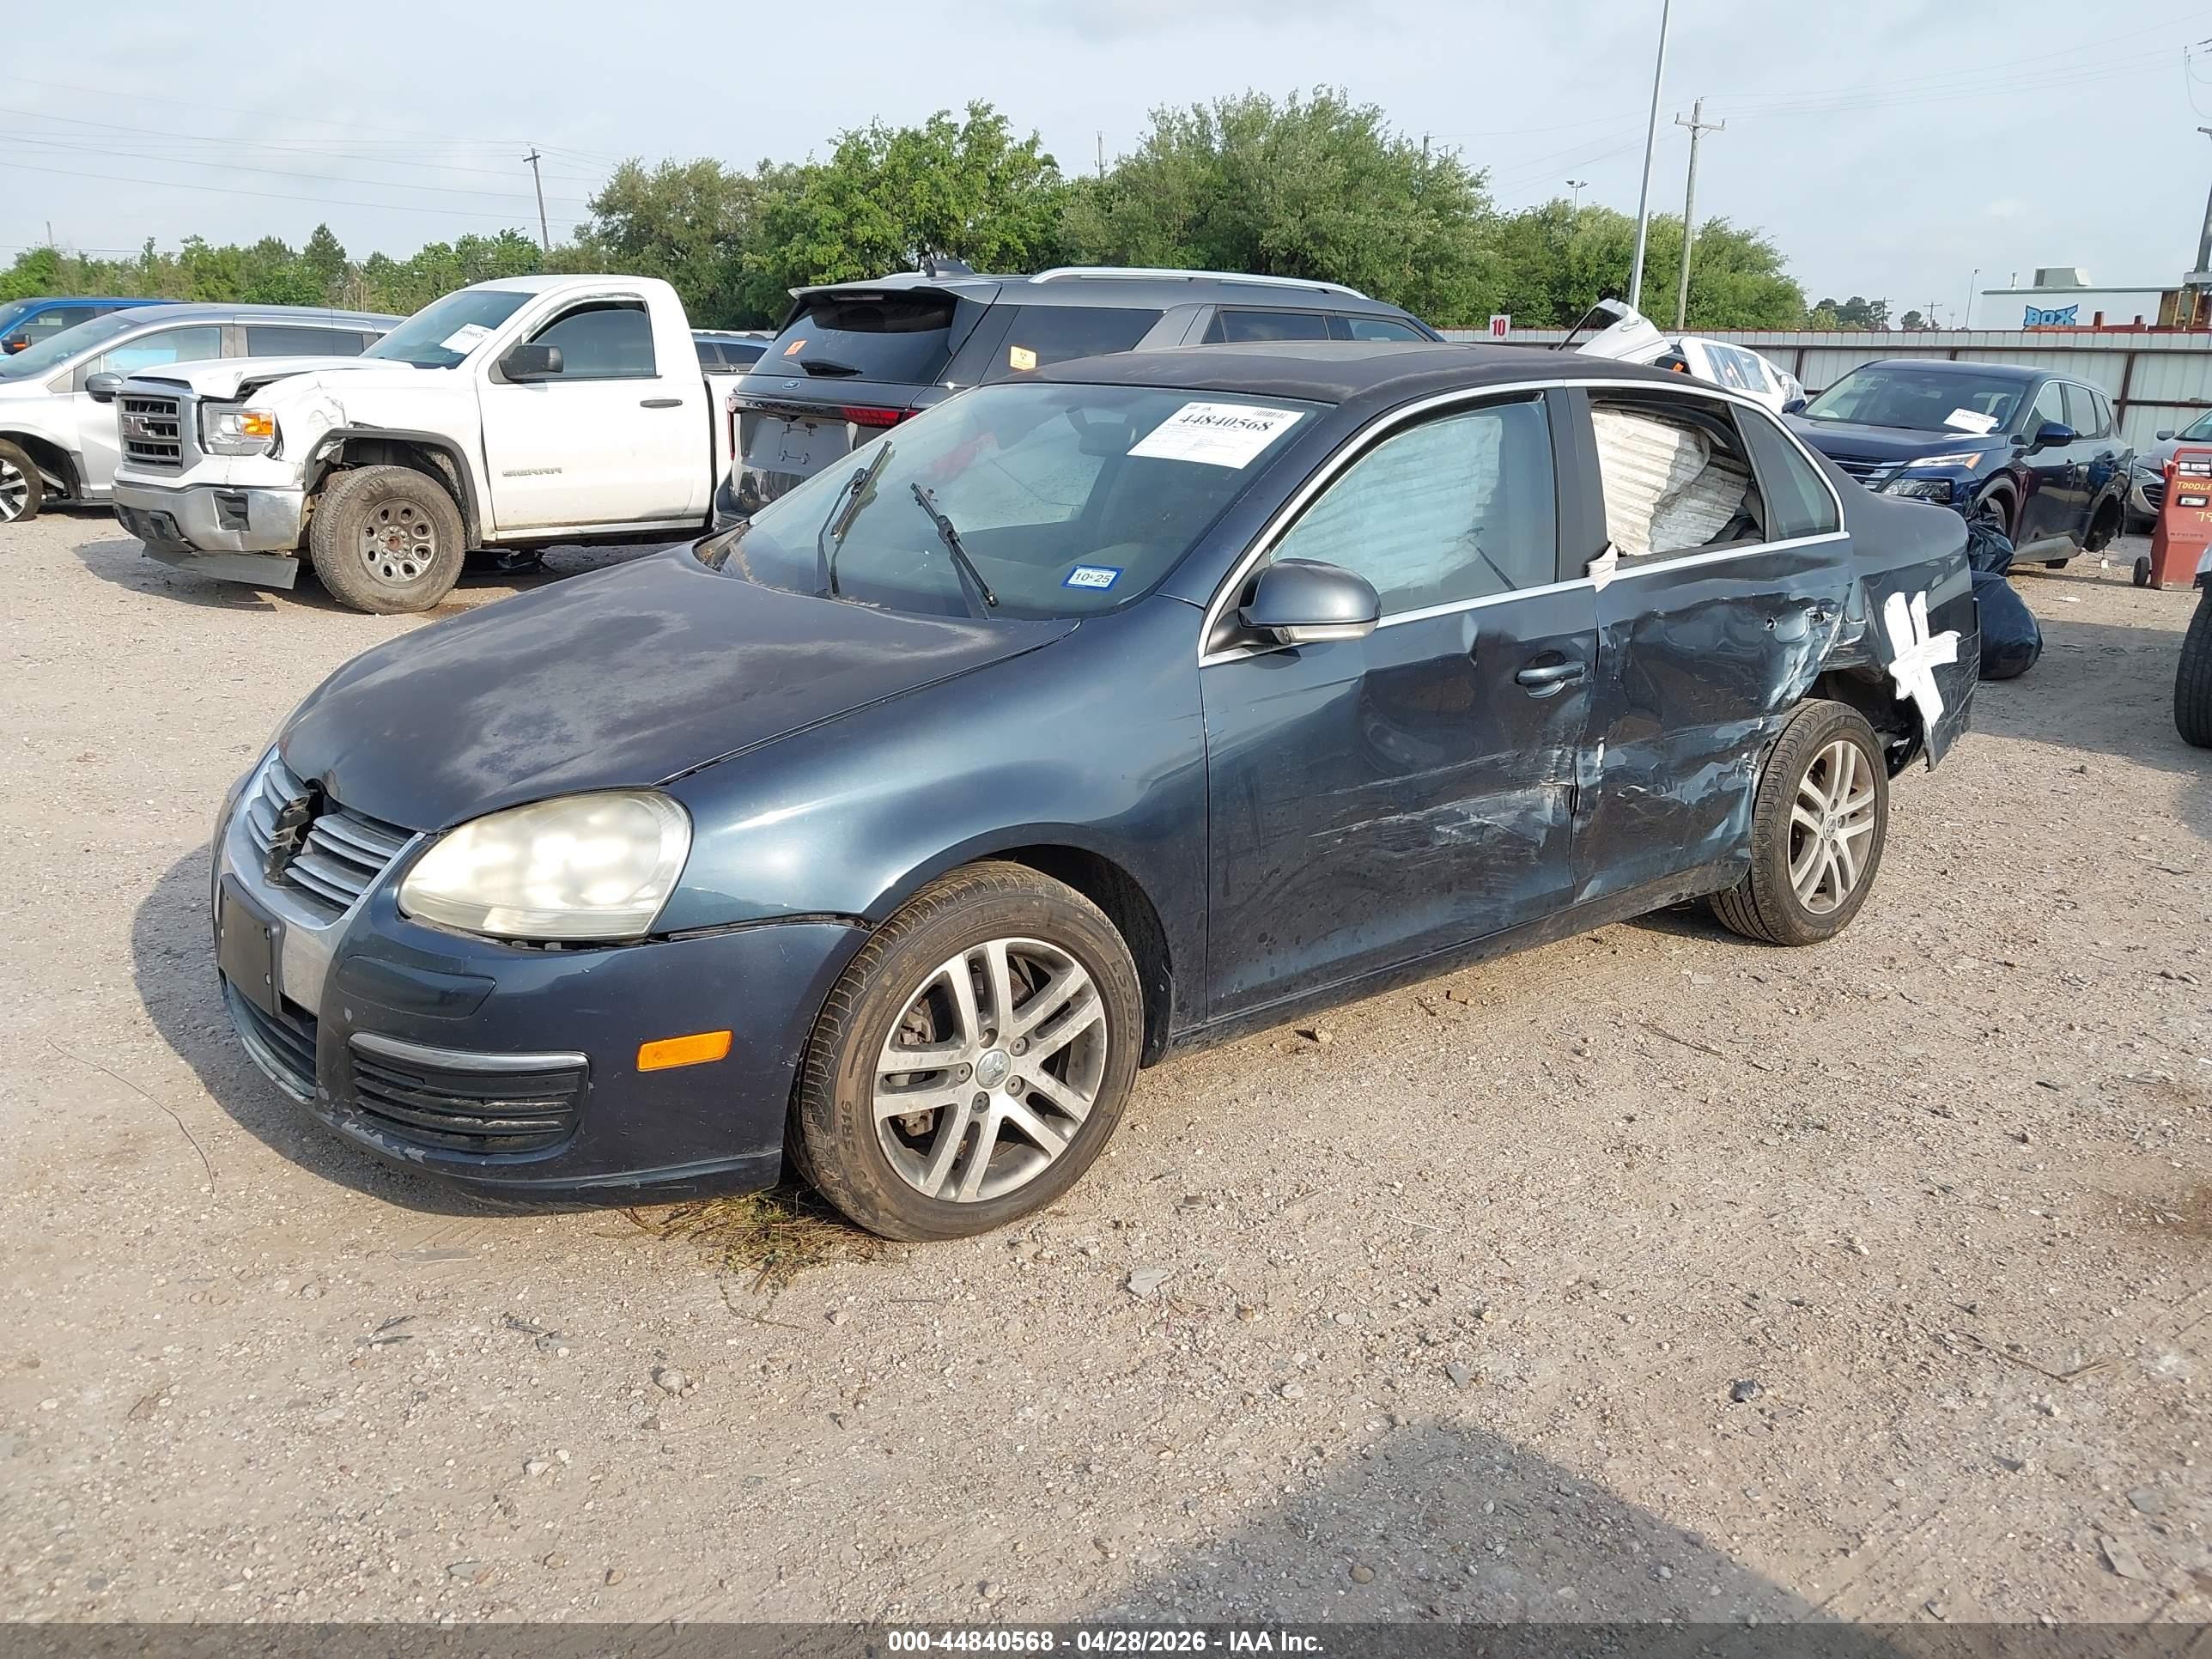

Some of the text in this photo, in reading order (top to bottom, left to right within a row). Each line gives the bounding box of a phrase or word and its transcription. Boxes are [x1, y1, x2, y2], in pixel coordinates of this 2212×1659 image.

[2024, 303, 2078, 326] BOX
[1492, 319, 1505, 336] 10
[1179, 413, 1274, 431] 44840568
[501, 467, 562, 477] SIERRA
